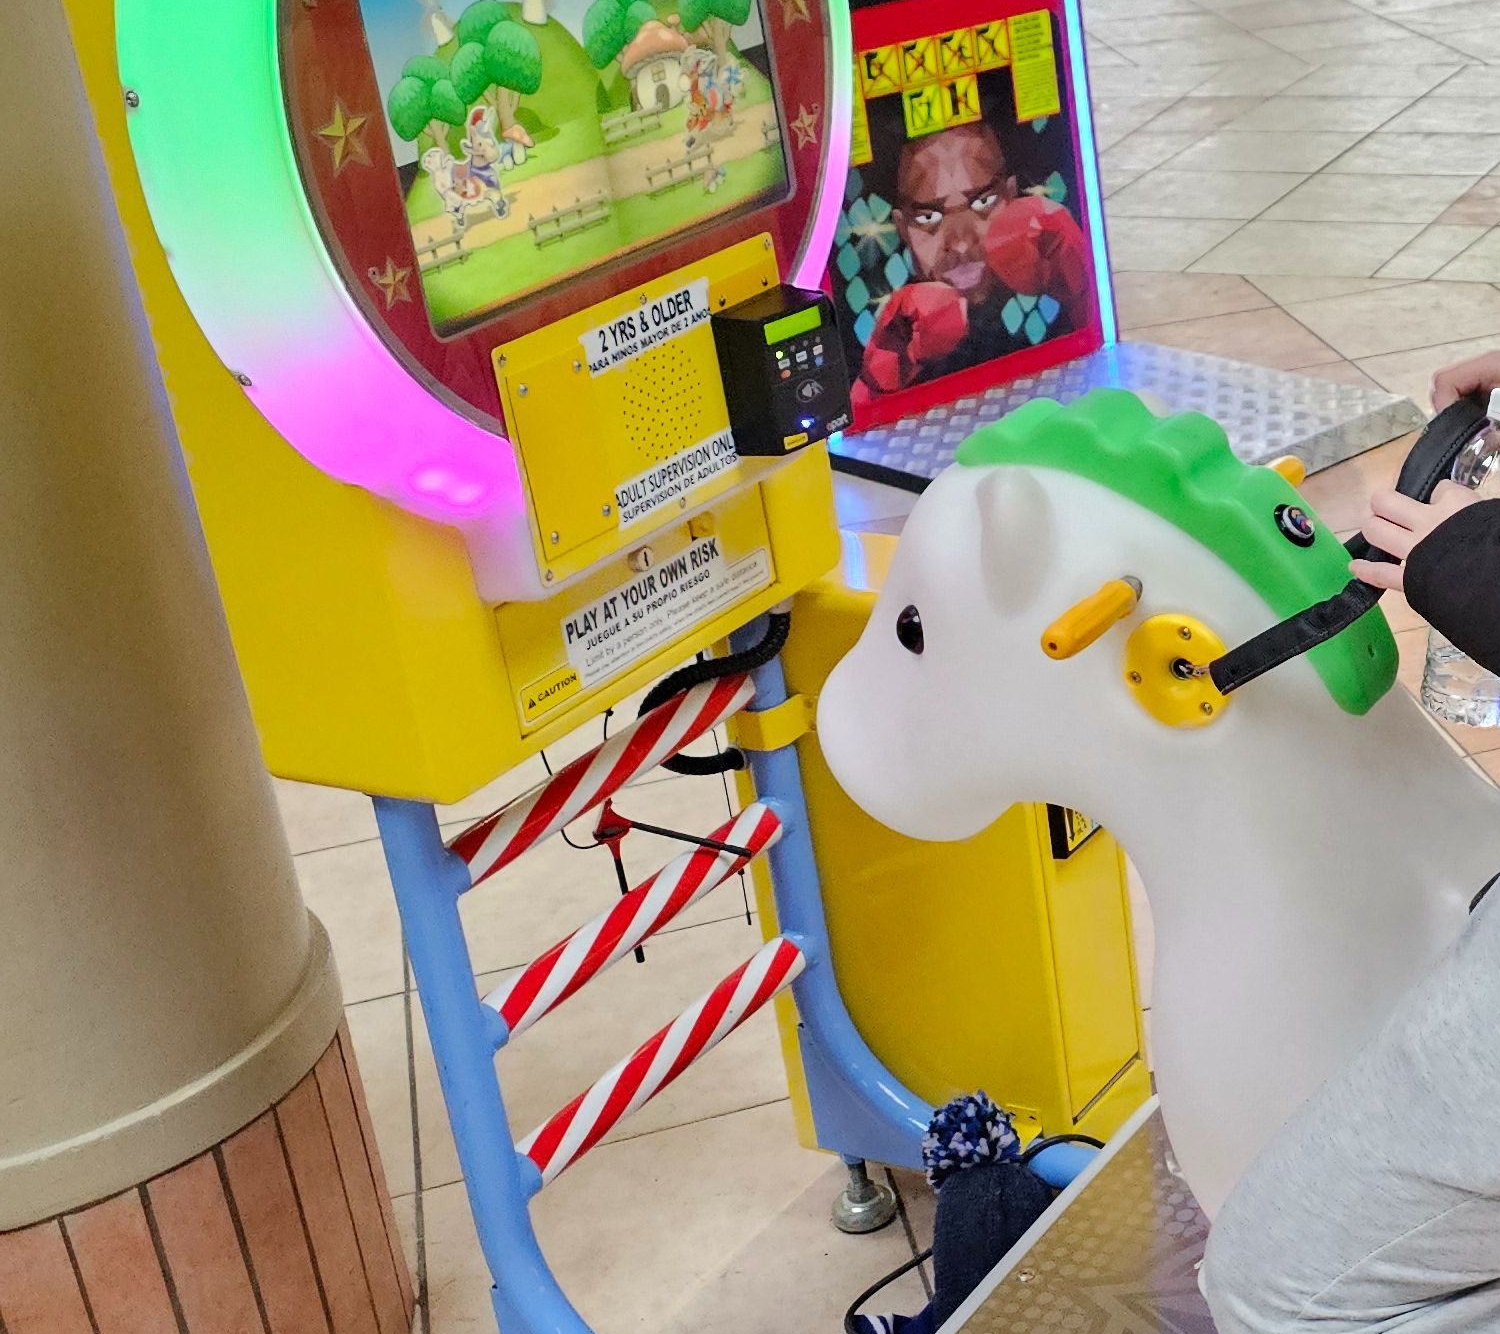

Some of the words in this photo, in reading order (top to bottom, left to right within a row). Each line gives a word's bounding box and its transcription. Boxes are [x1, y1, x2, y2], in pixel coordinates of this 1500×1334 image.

[598, 329, 609, 353] 2
[608, 316, 636, 346] YRS
[639, 310, 650, 333] &
[651, 289, 694, 326] OLDER
[640, 326, 670, 349] MAYOR
[671, 320, 682, 334] DE
[616, 478, 647, 508] ADULT
[648, 444, 711, 492] SUPERVISION
[712, 433, 734, 457] ONL
[623, 484, 682, 523] SUPERVISION
[684, 474, 695, 488] DE
[697, 452, 738, 480] ADULTOS
[565, 607, 598, 645] PLAY
[603, 596, 618, 624] AT
[620, 574, 658, 610] YOUR
[659, 555, 688, 588] OWN
[690, 537, 719, 571] RISK
[586, 621, 621, 651] JUEGUE
[624, 618, 631, 627] A
[632, 607, 644, 623] SU
[646, 588, 678, 615] PROPIO
[680, 569, 710, 593] RIESGO
[537, 672, 577, 702] CAUTION
